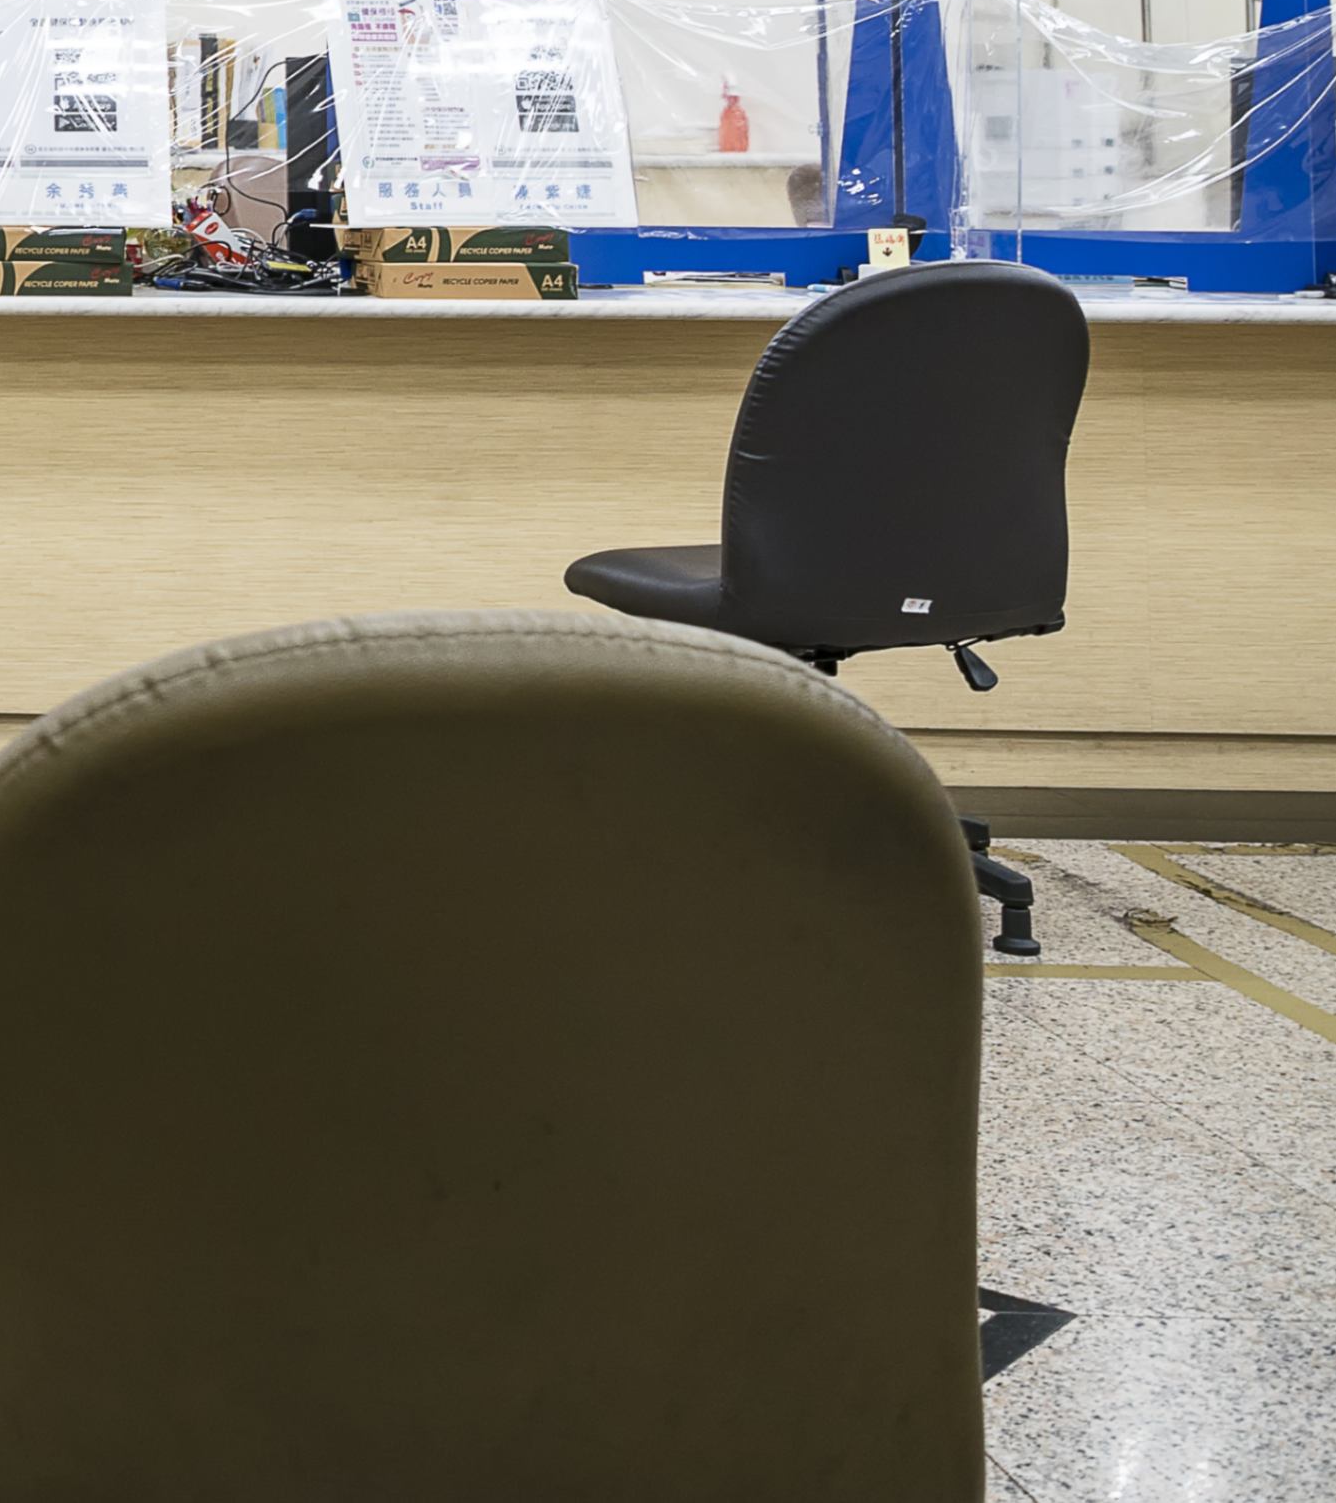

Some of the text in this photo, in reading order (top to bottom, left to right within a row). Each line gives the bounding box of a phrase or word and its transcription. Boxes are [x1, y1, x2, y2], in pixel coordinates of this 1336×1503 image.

[378, 182, 474, 198] 服務人員
[410, 201, 444, 210] Staff
[406, 235, 427, 248] A4
[15, 247, 91, 255] RECYCLE COPIER PAPER
[459, 247, 533, 255] RECYCLE COPIER PAPER
[24, 280, 99, 288] RECYCLE COPIER PAPER
[442, 274, 564, 288] RECYCLE COPIER PAPER A4
